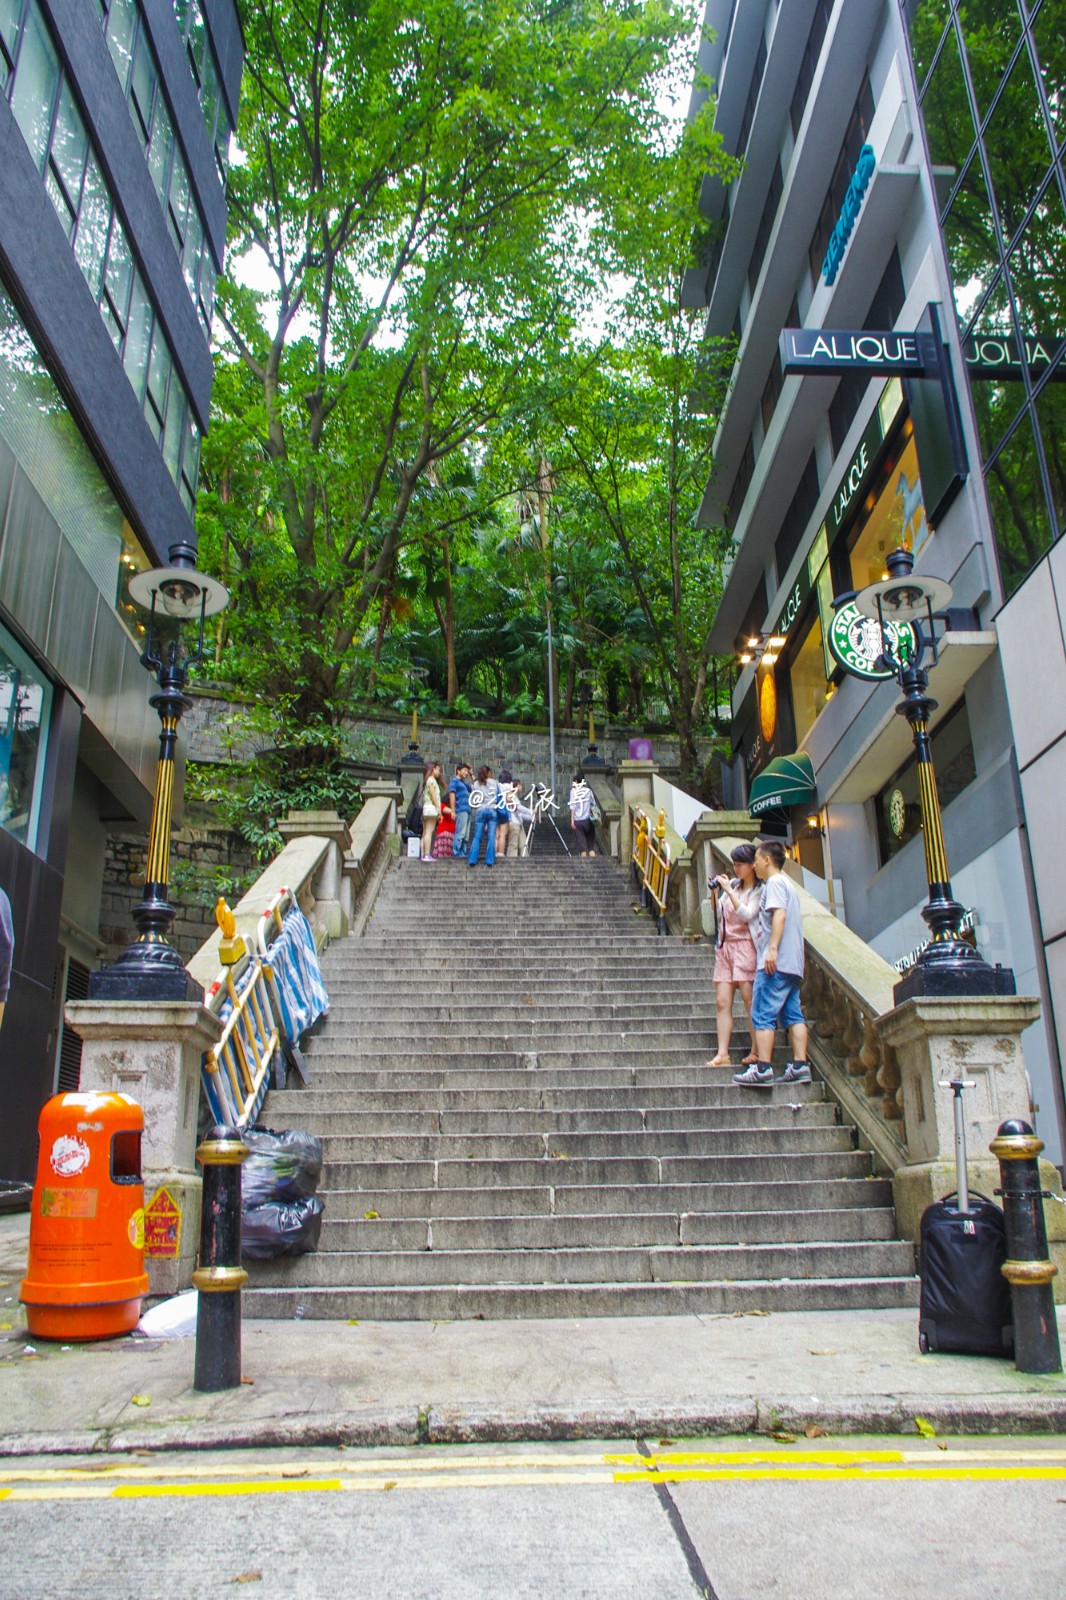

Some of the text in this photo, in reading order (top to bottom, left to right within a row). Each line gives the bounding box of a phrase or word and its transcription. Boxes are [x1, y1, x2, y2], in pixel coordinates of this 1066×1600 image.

[791, 335, 918, 362] LALIQUE
[833, 442, 869, 526] LALIQUE
[752, 795, 783, 813] COFFEE
